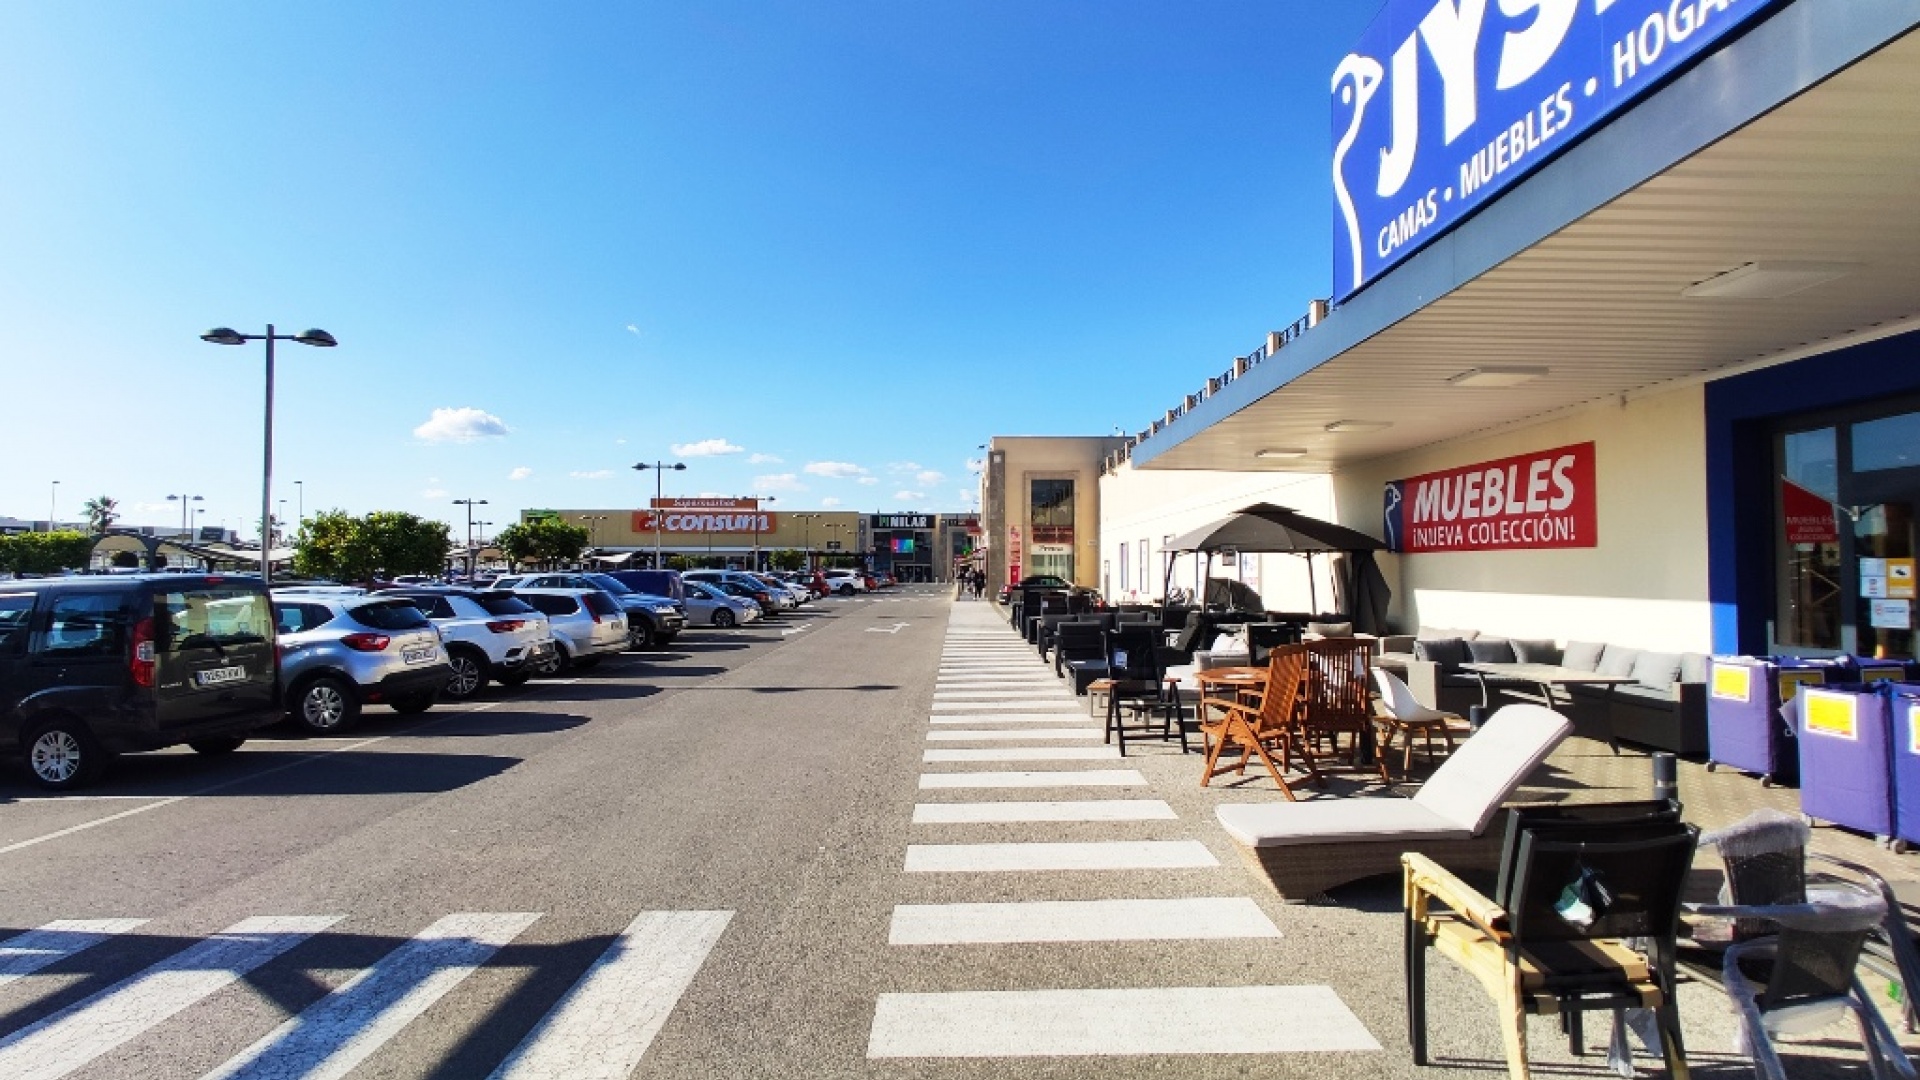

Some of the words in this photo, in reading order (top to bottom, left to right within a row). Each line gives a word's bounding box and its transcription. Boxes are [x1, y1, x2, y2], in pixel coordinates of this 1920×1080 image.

[1376, 0, 1620, 197] JYS
[1377, 187, 1437, 258] CAMAS
[1460, 81, 1573, 199] MUEBLES
[1413, 454, 1576, 523] MUEBLES
[1413, 523, 1464, 548] ¡NUEVA
[1468, 512, 1576, 545] COLECCIÓN!
